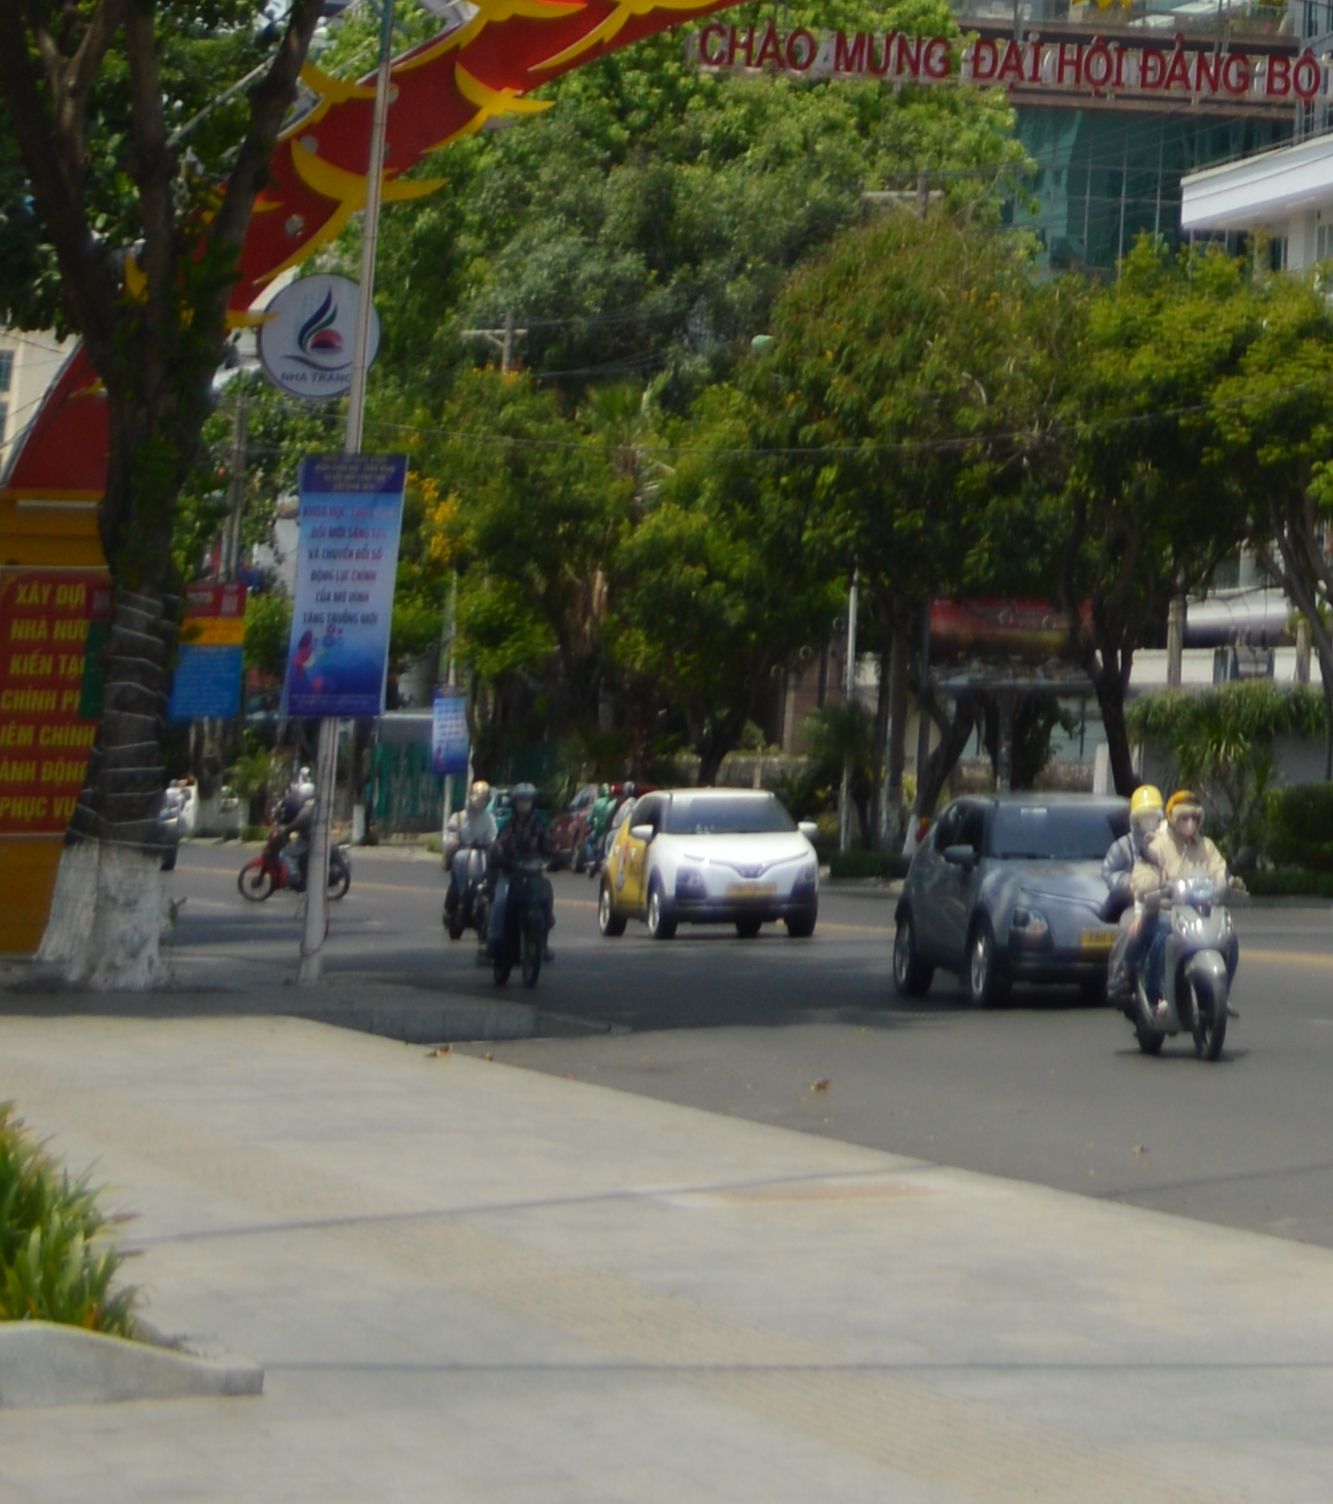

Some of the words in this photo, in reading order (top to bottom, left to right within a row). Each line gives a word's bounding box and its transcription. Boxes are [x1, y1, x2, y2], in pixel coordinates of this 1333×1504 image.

[700, 13, 816, 71] CHÀO
[971, 39, 1044, 91] ĐẠI
[1057, 34, 1126, 96] HỘI
[1139, 32, 1251, 94] ĐẢNG
[1266, 47, 1322, 107] BỘ
[281, 372, 307, 383] NHA
[17, 580, 52, 605] XÂY
[56, 583, 86, 609] DỰ
[59, 654, 85, 678] TẠ
[40, 720, 96, 746] CHÍNH
